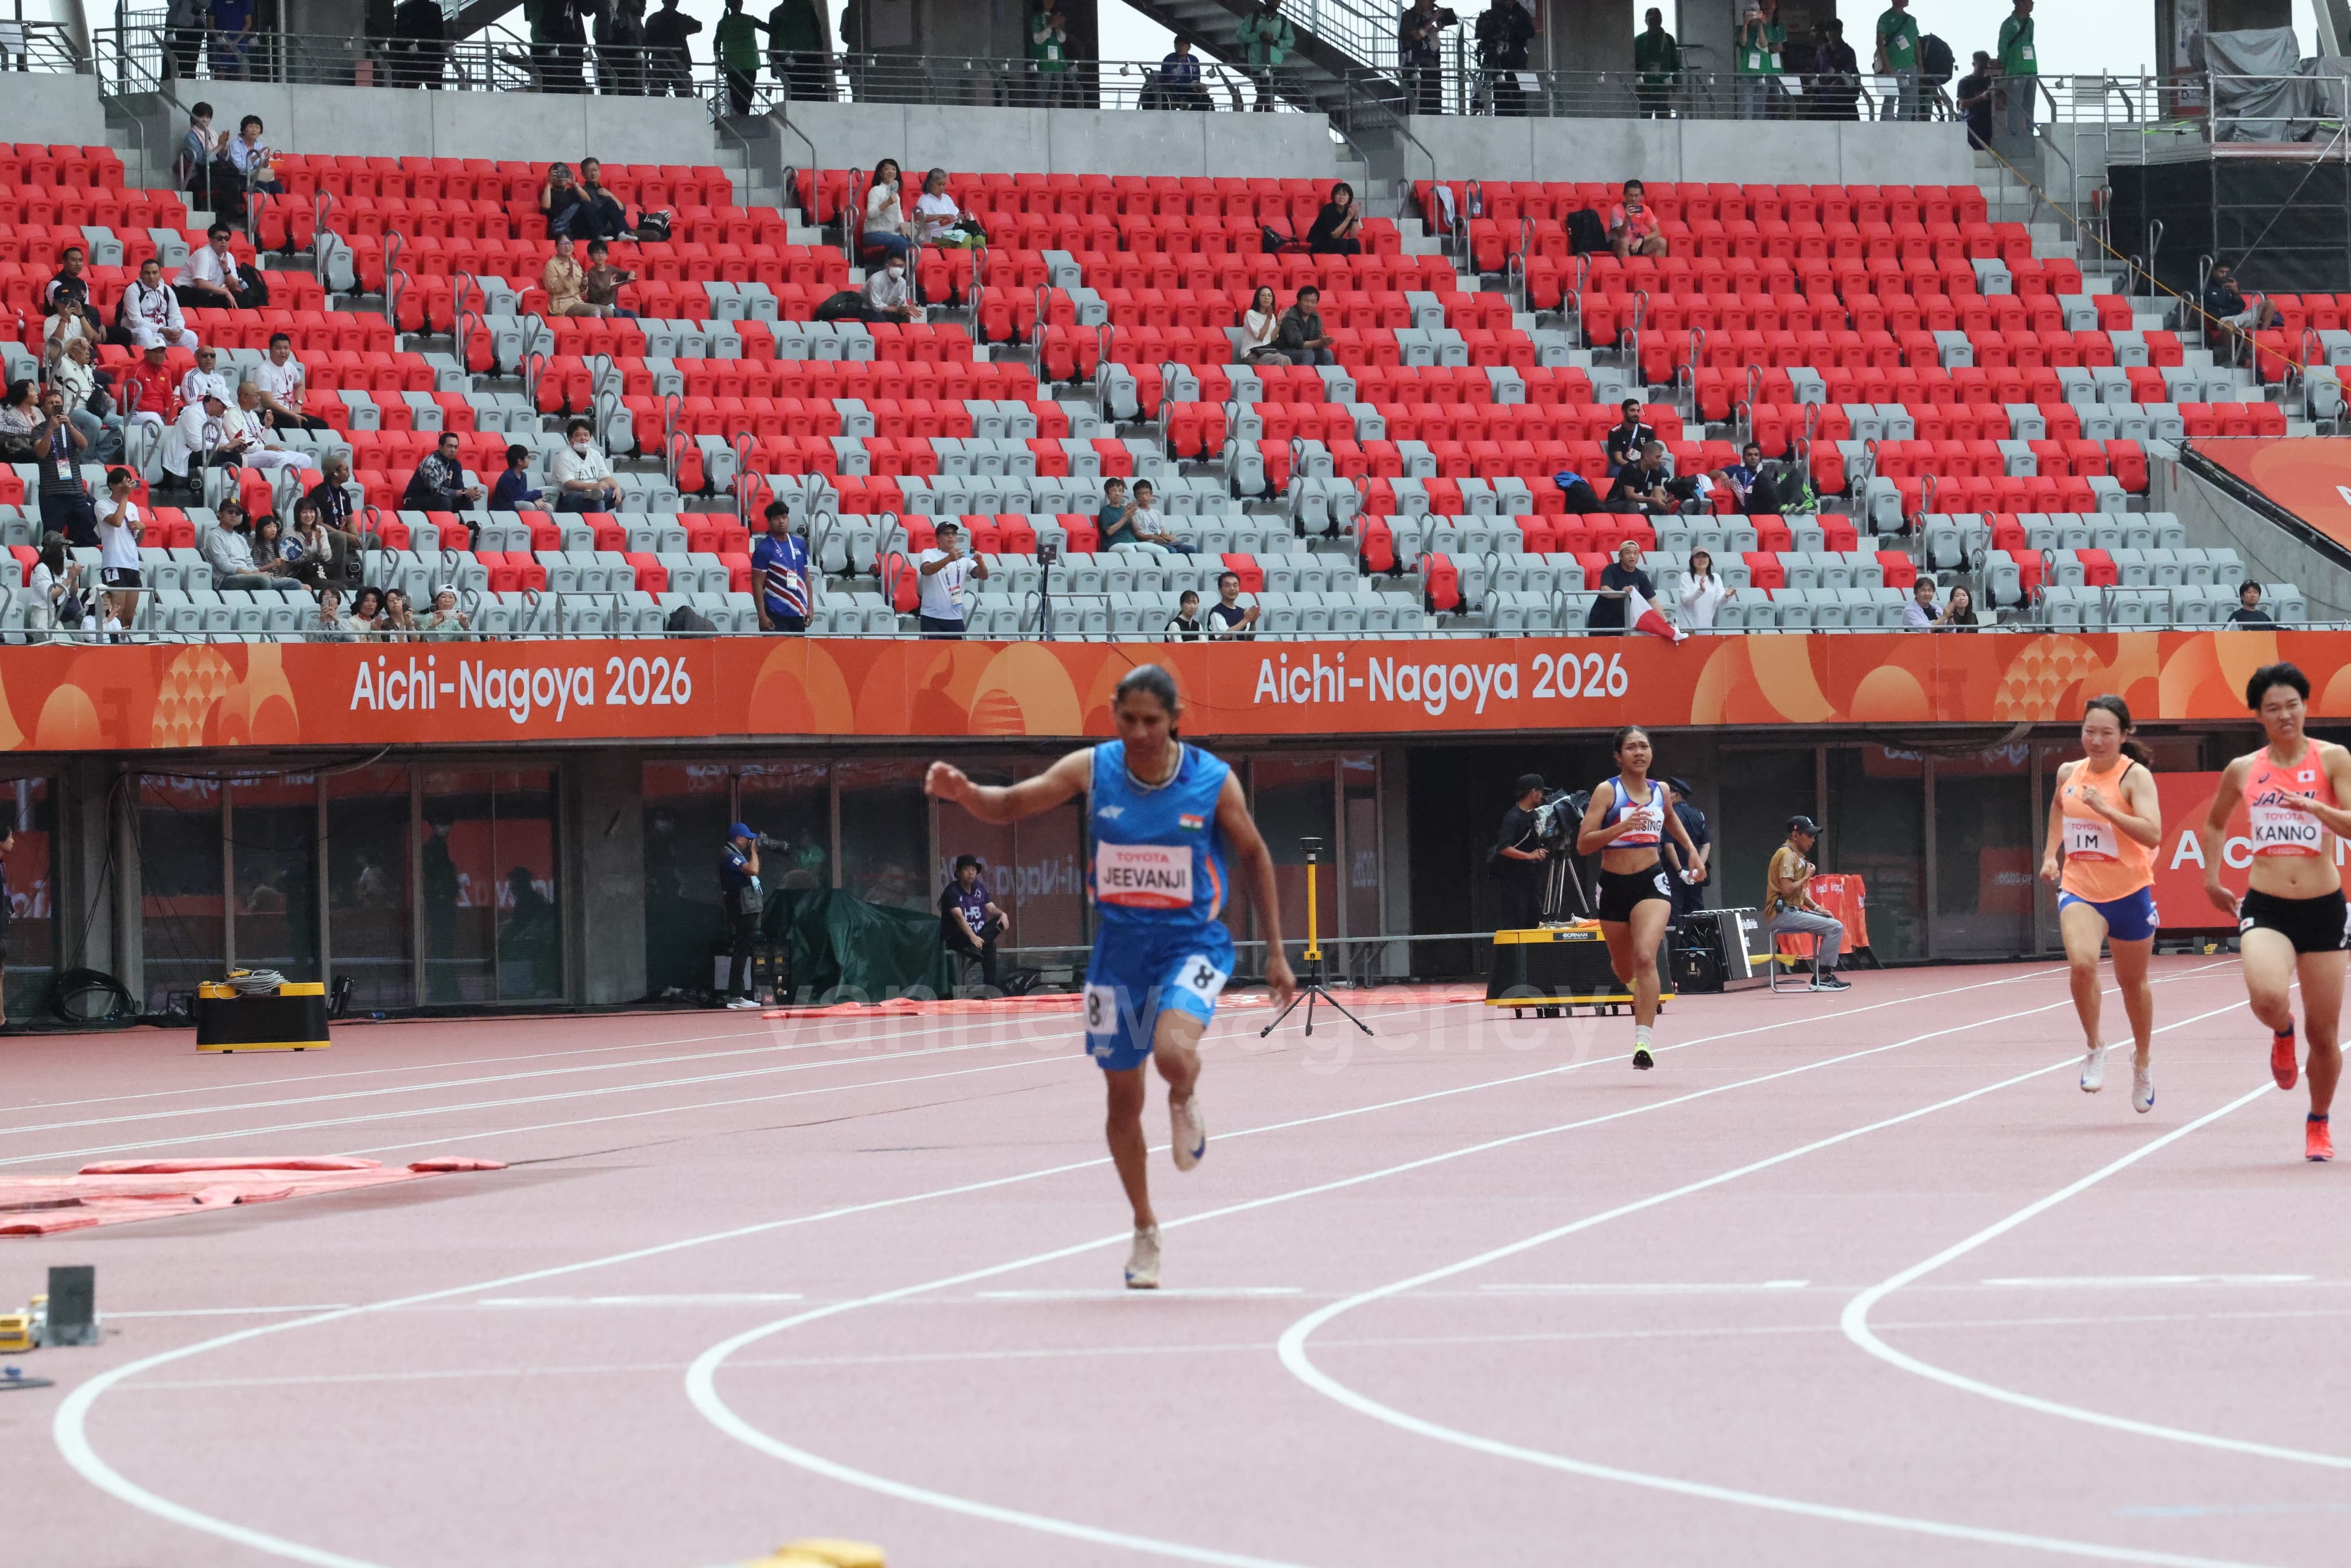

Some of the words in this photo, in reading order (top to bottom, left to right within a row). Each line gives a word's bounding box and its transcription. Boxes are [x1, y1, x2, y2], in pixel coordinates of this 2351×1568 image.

[351, 654, 594, 724] Aichi-Nagoya
[606, 656, 692, 705] 2026
[1254, 652, 1518, 716] Aichi-Nagoya
[1532, 653, 1628, 698] 2026
[2072, 823, 2103, 832] TOYOTA
[2264, 813, 2305, 821] TOYOTA
[2255, 826, 2316, 840] KANNO
[1116, 852, 1169, 863] TOYOTA
[1103, 867, 1186, 888] JEEVANJI
[1193, 965, 1215, 989] 8
[1089, 992, 1100, 1026] 8
